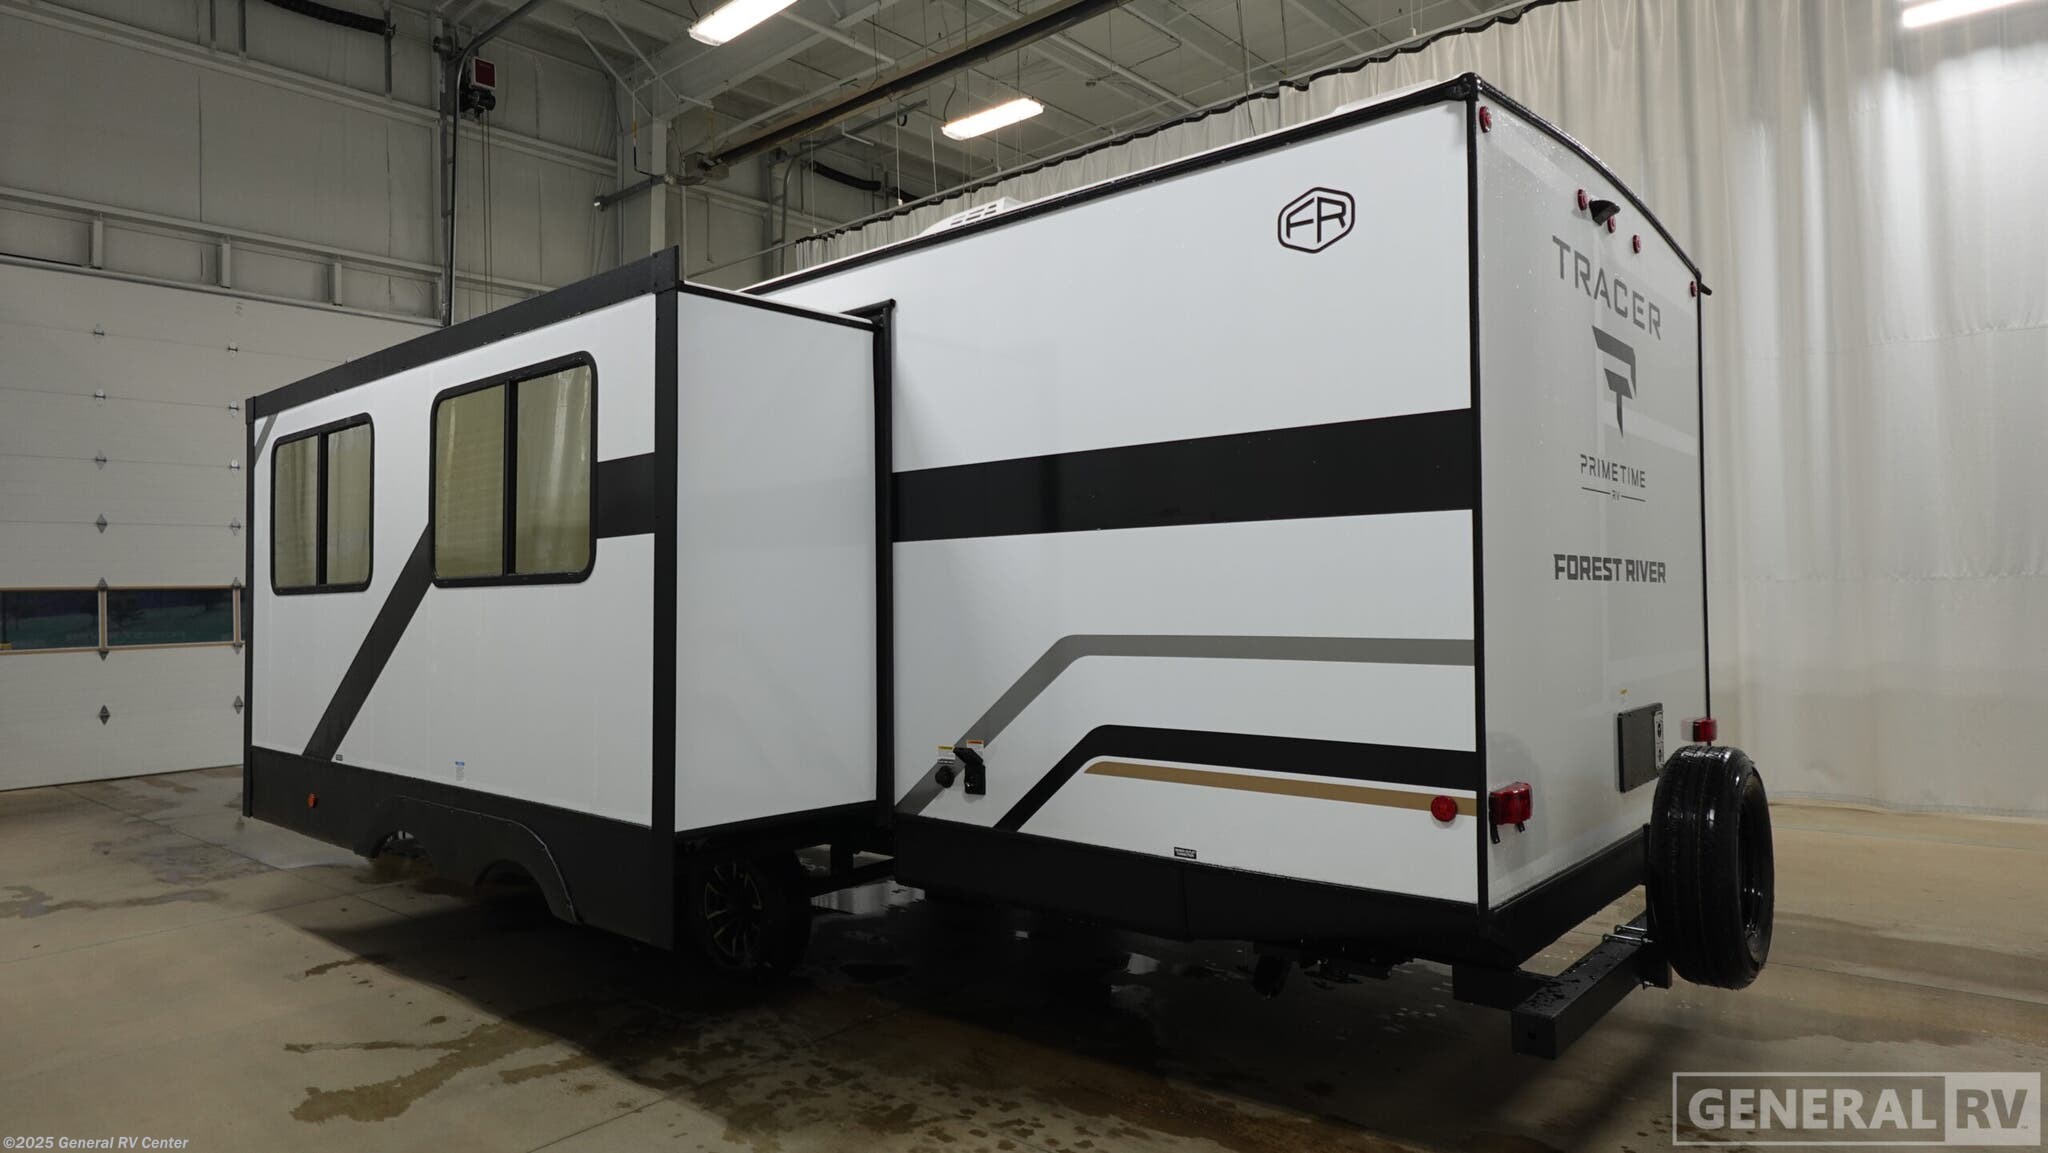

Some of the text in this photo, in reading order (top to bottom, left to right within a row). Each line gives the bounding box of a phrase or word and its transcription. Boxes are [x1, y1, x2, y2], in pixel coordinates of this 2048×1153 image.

[1552, 235, 1661, 340] TRACER
[1580, 454, 1646, 488] PRIMETIME
[1553, 553, 1667, 583] FOREST RIVER
